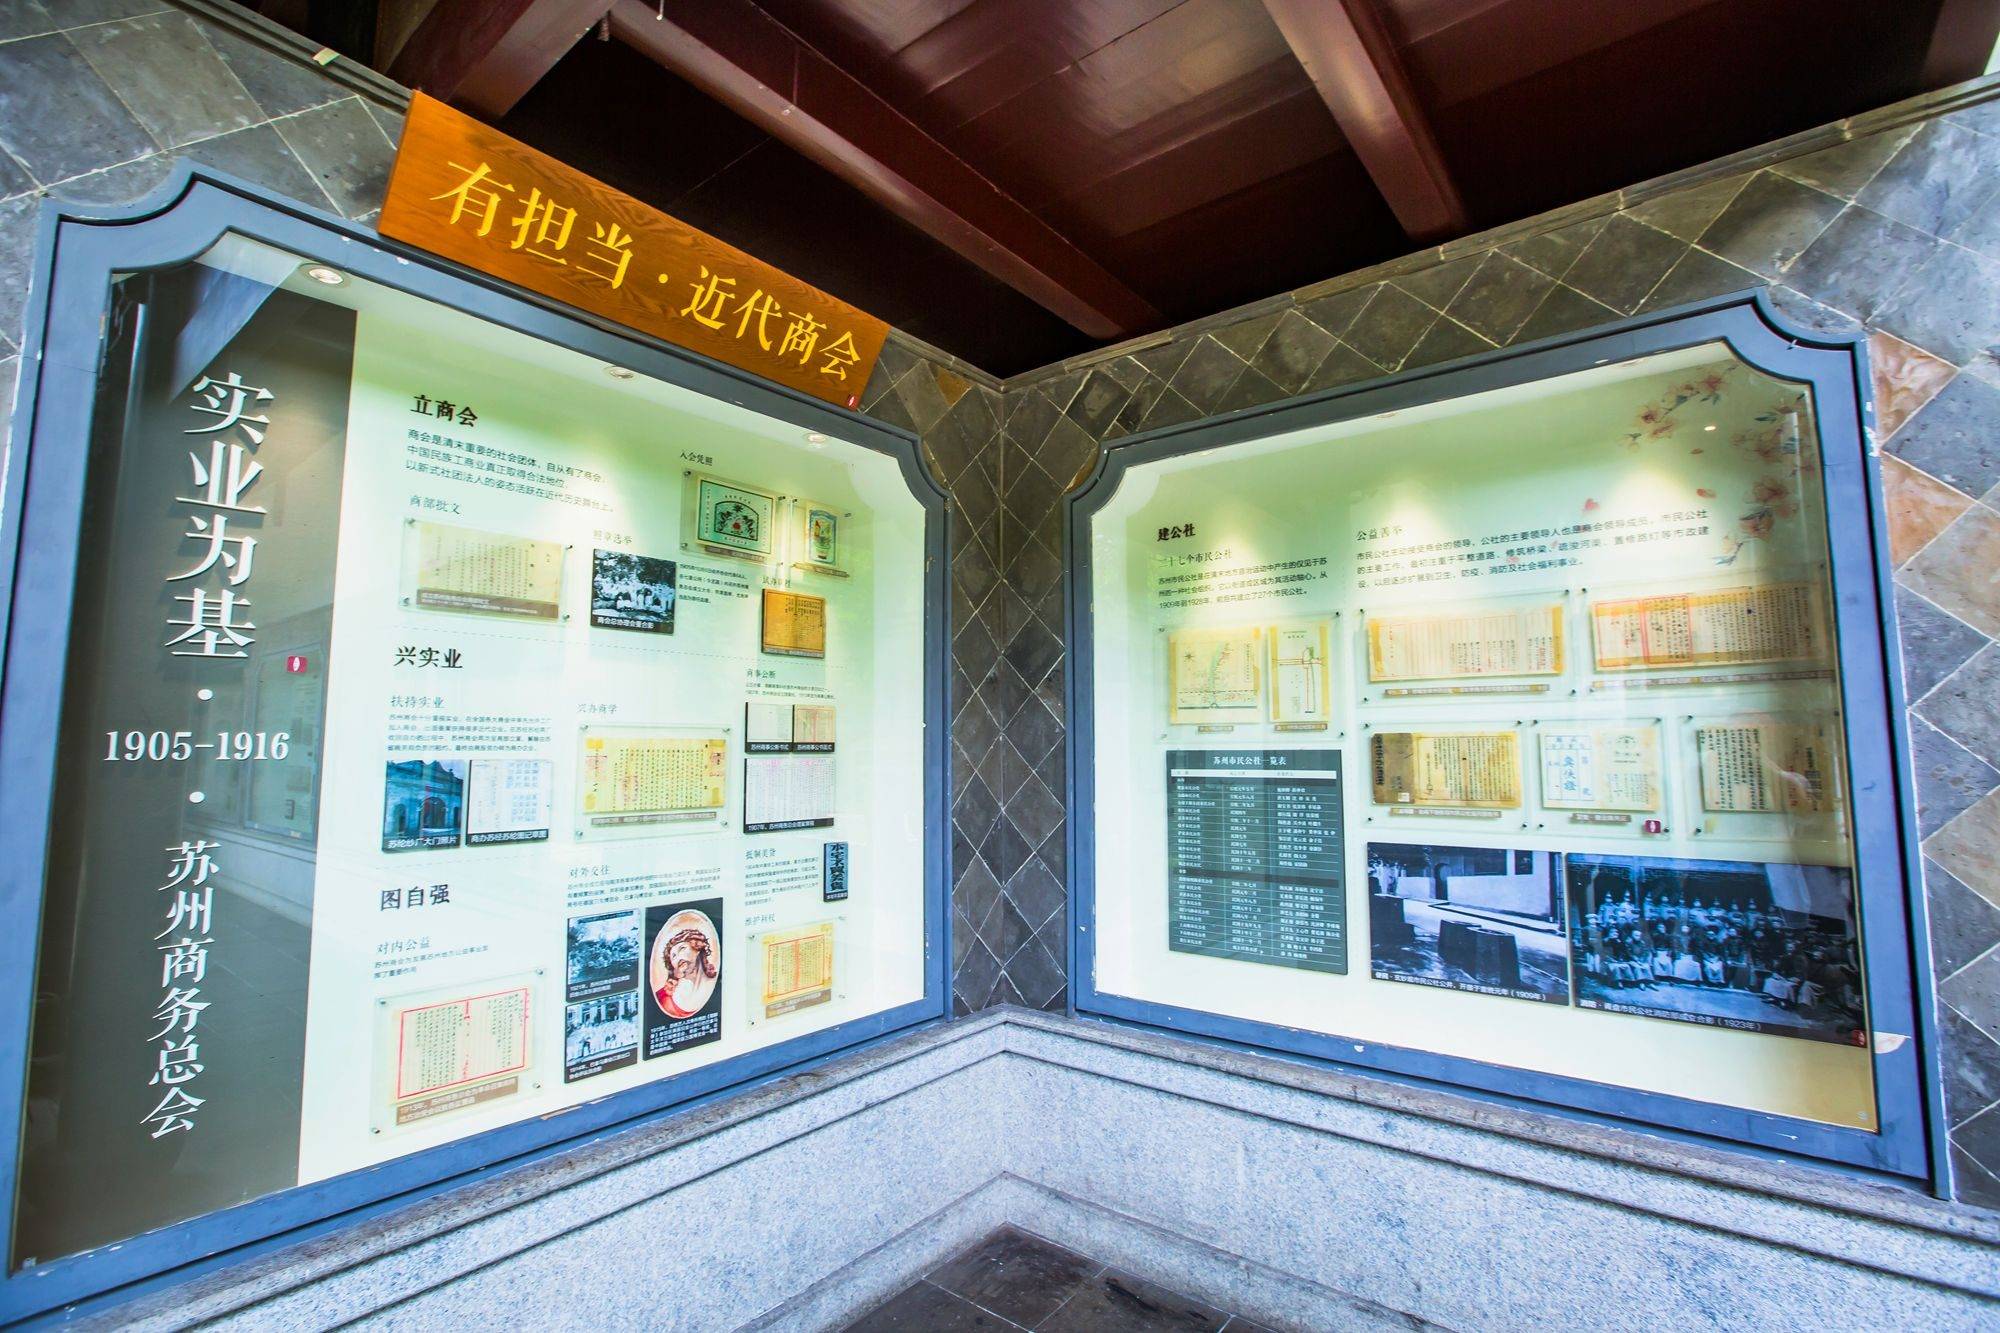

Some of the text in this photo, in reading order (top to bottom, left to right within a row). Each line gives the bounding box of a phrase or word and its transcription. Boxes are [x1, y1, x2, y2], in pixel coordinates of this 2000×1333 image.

[430, 161, 860, 382] 有担当·近代商会
[410, 395, 478, 427] 立商会
[164, 372, 275, 658] 实业为基
[1157, 523, 1196, 542] 建公社
[393, 646, 463, 669] 兴实业
[380, 884, 450, 911] 图自强
[139, 840, 222, 1139] 苏州商务总会
